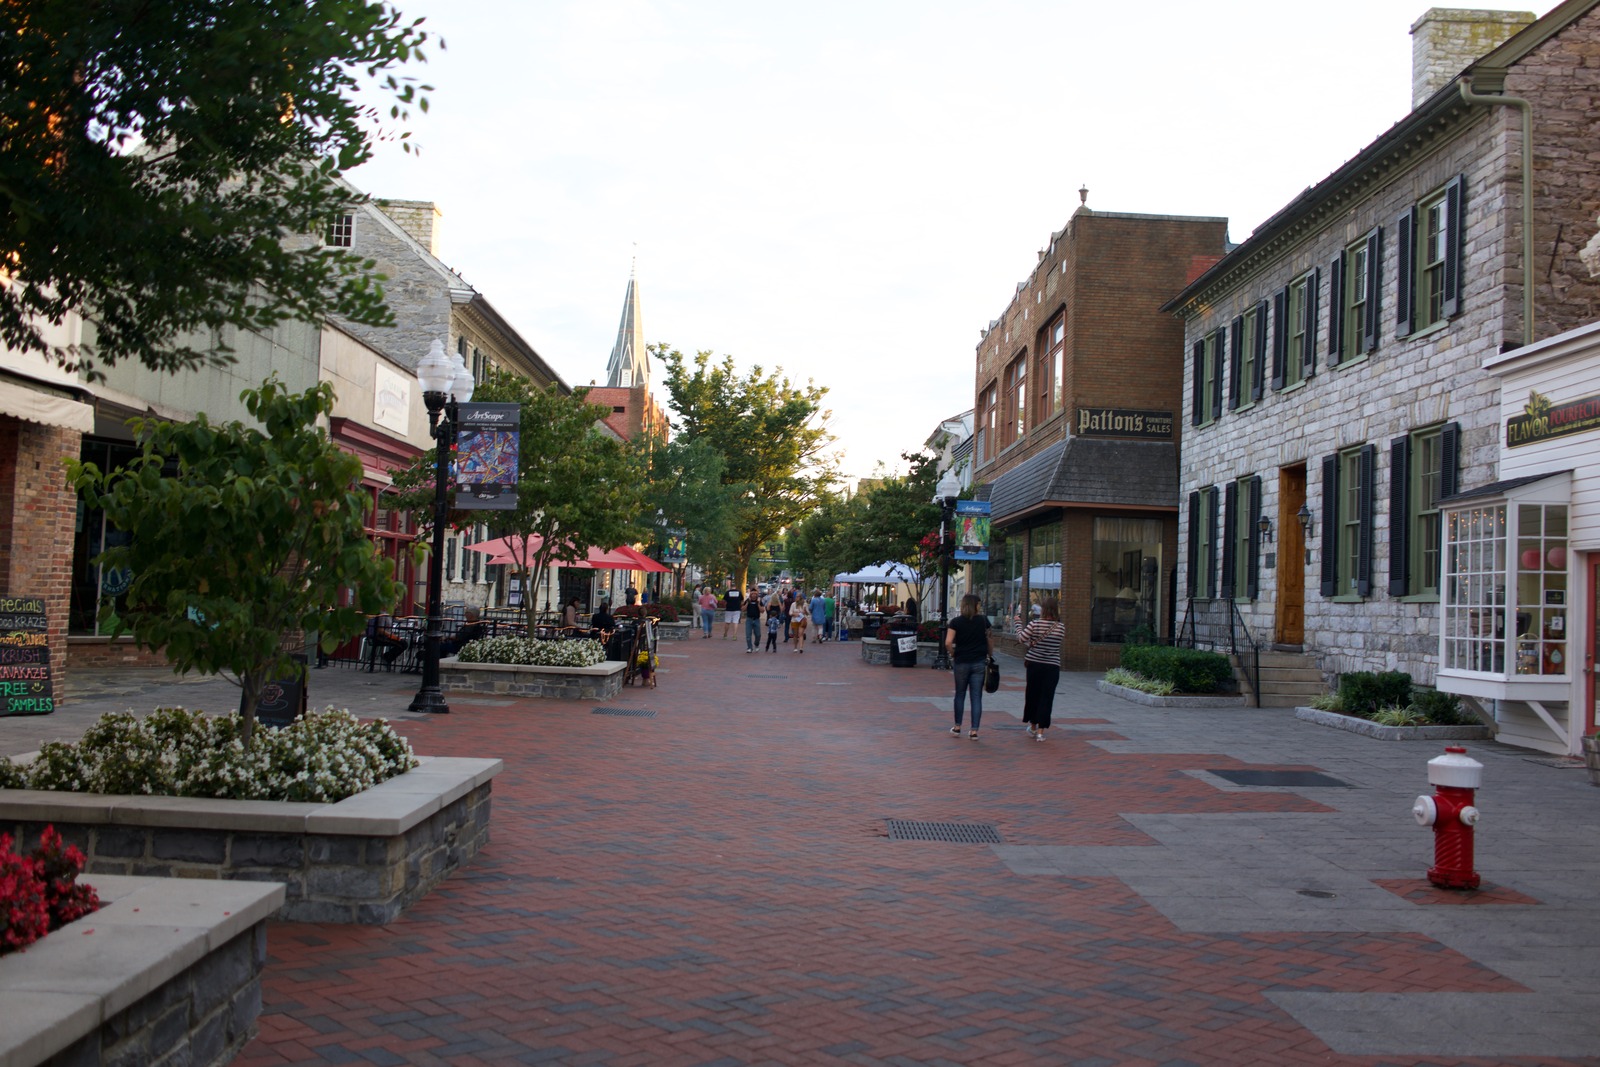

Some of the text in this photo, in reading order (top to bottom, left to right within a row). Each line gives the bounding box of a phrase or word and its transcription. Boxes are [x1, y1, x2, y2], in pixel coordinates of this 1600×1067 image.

[467, 411, 504, 421] ArtScape
[1078, 409, 1144, 433] Patton's
[1146, 424, 1171, 433] SALES
[1508, 416, 1550, 442] FLAVOR
[14, 616, 48, 628] KRAZE
[1, 649, 40, 662] KRUSH
[0, 681, 29, 697] FREE
[7, 697, 53, 712] SAMPLES
